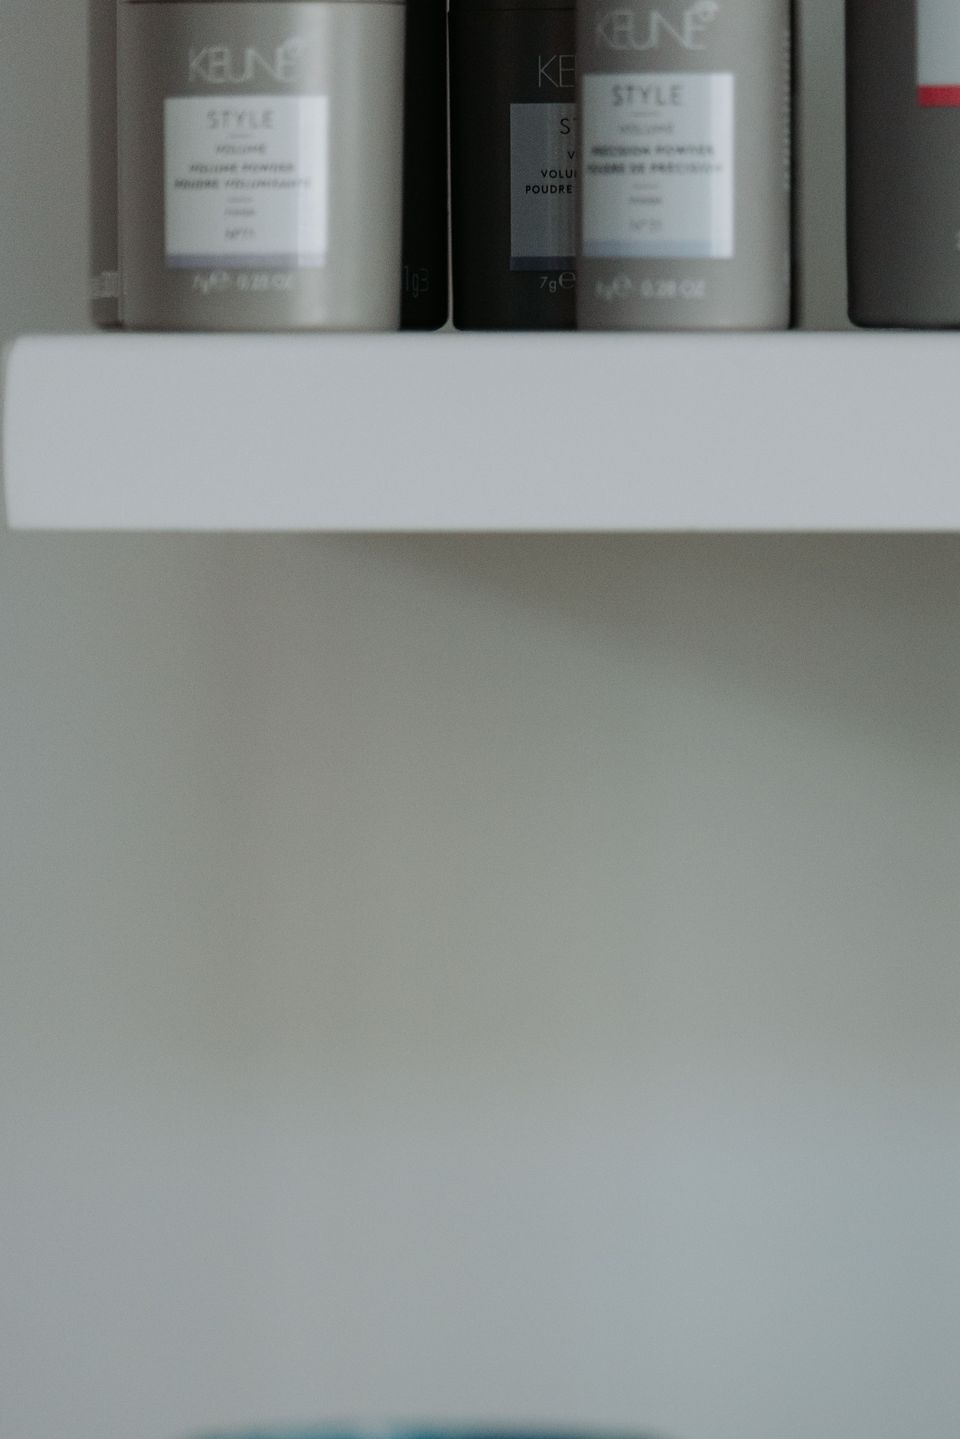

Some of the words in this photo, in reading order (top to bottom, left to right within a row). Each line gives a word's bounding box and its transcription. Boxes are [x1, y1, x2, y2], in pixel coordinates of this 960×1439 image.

[611, 84, 683, 107] STYLE
[207, 110, 275, 129] STYLE
[540, 169, 576, 179] VOLU
[525, 185, 573, 194] POUDRE
